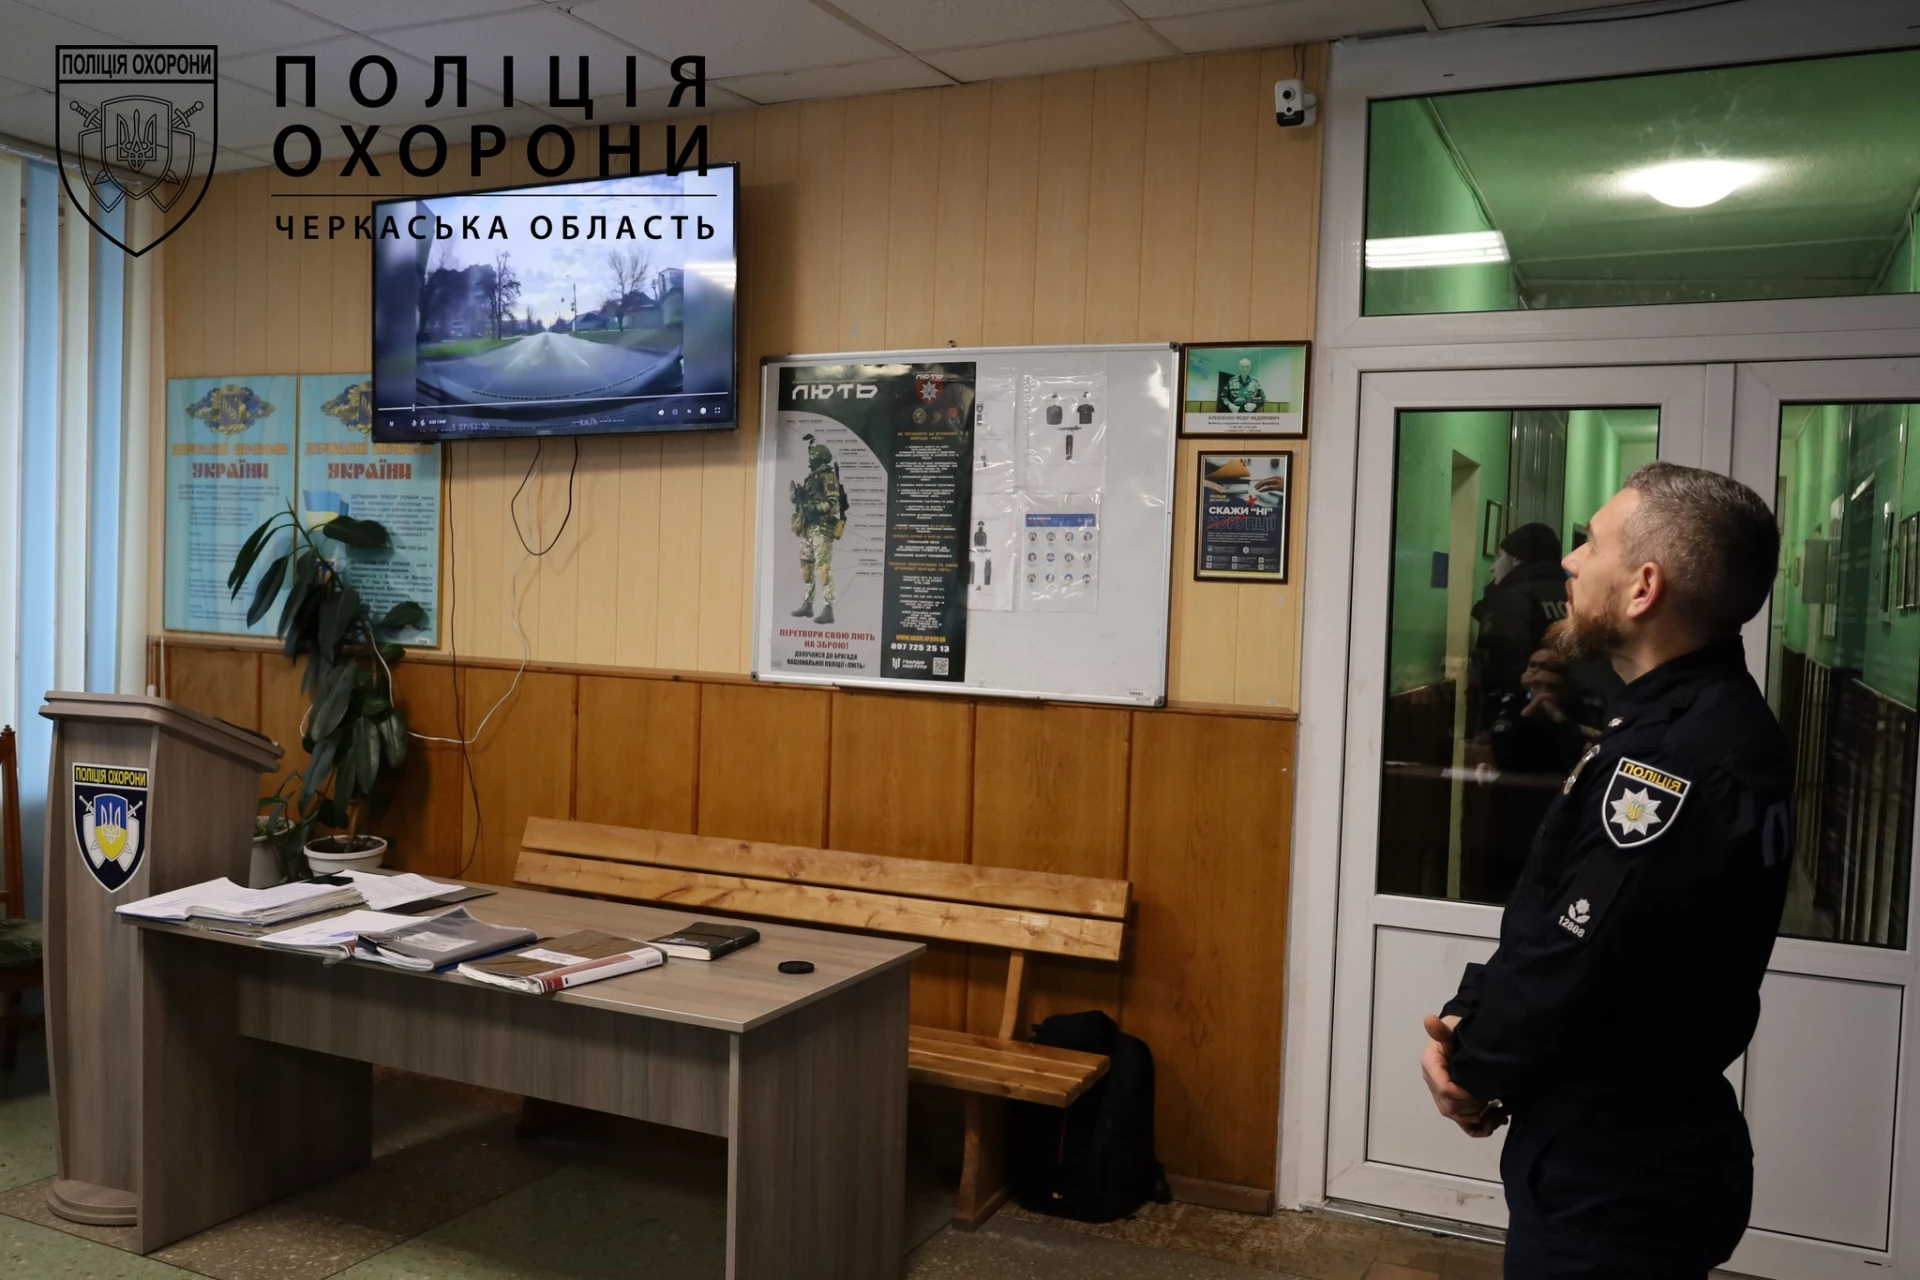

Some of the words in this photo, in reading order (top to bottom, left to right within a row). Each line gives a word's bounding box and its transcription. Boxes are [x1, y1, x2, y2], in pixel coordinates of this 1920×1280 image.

[791, 383, 878, 400] ЛЮТЬ
[192, 458, 269, 479] УКРАЇНИ
[328, 458, 412, 480] УКРАЇНИ
[1208, 506, 1249, 515] СКАЖИ
[780, 629, 823, 639] ПЕРЕТВОРИ
[825, 631, 850, 640] СВОЮ
[851, 632, 876, 641] ЛЮТЬ
[804, 640, 815, 648] НА
[816, 641, 849, 650] ЗБРОЮ!
[891, 642, 907, 650] 097
[908, 643, 924, 651] 725
[926, 644, 938, 652] 25
[939, 645, 950, 653] 13
[75, 767, 107, 784] ПОЛІЦІЯ
[108, 769, 146, 786] ОХОРОНИ
[1622, 762, 1682, 792] ПОЛІЦІЯ
[1558, 915, 1586, 938] 12808
